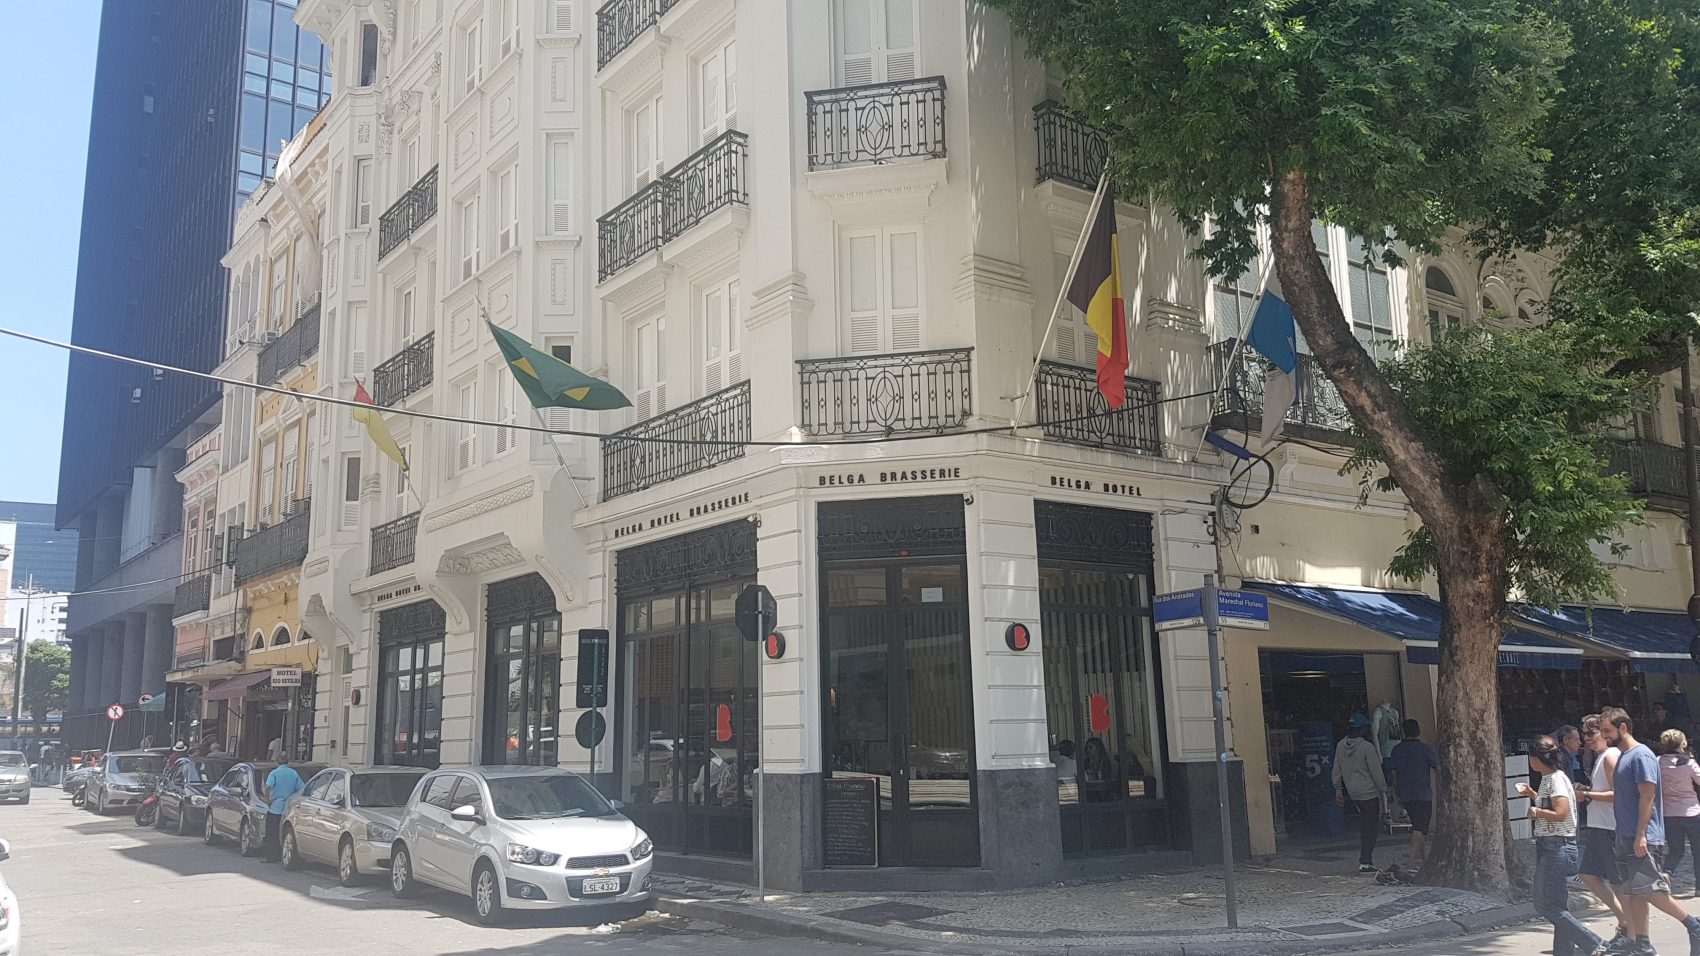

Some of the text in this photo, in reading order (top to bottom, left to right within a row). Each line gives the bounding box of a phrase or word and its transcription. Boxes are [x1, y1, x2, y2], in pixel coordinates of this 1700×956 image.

[818, 467, 960, 486] BELGA BRASSERIE
[1050, 475, 1142, 496] BELGA HOTEL
[614, 492, 749, 538] BELGA HOTEL BRASSERIE
[1218, 590, 1241, 598] Avenida
[1218, 597, 1264, 608] Marechal Floriano
